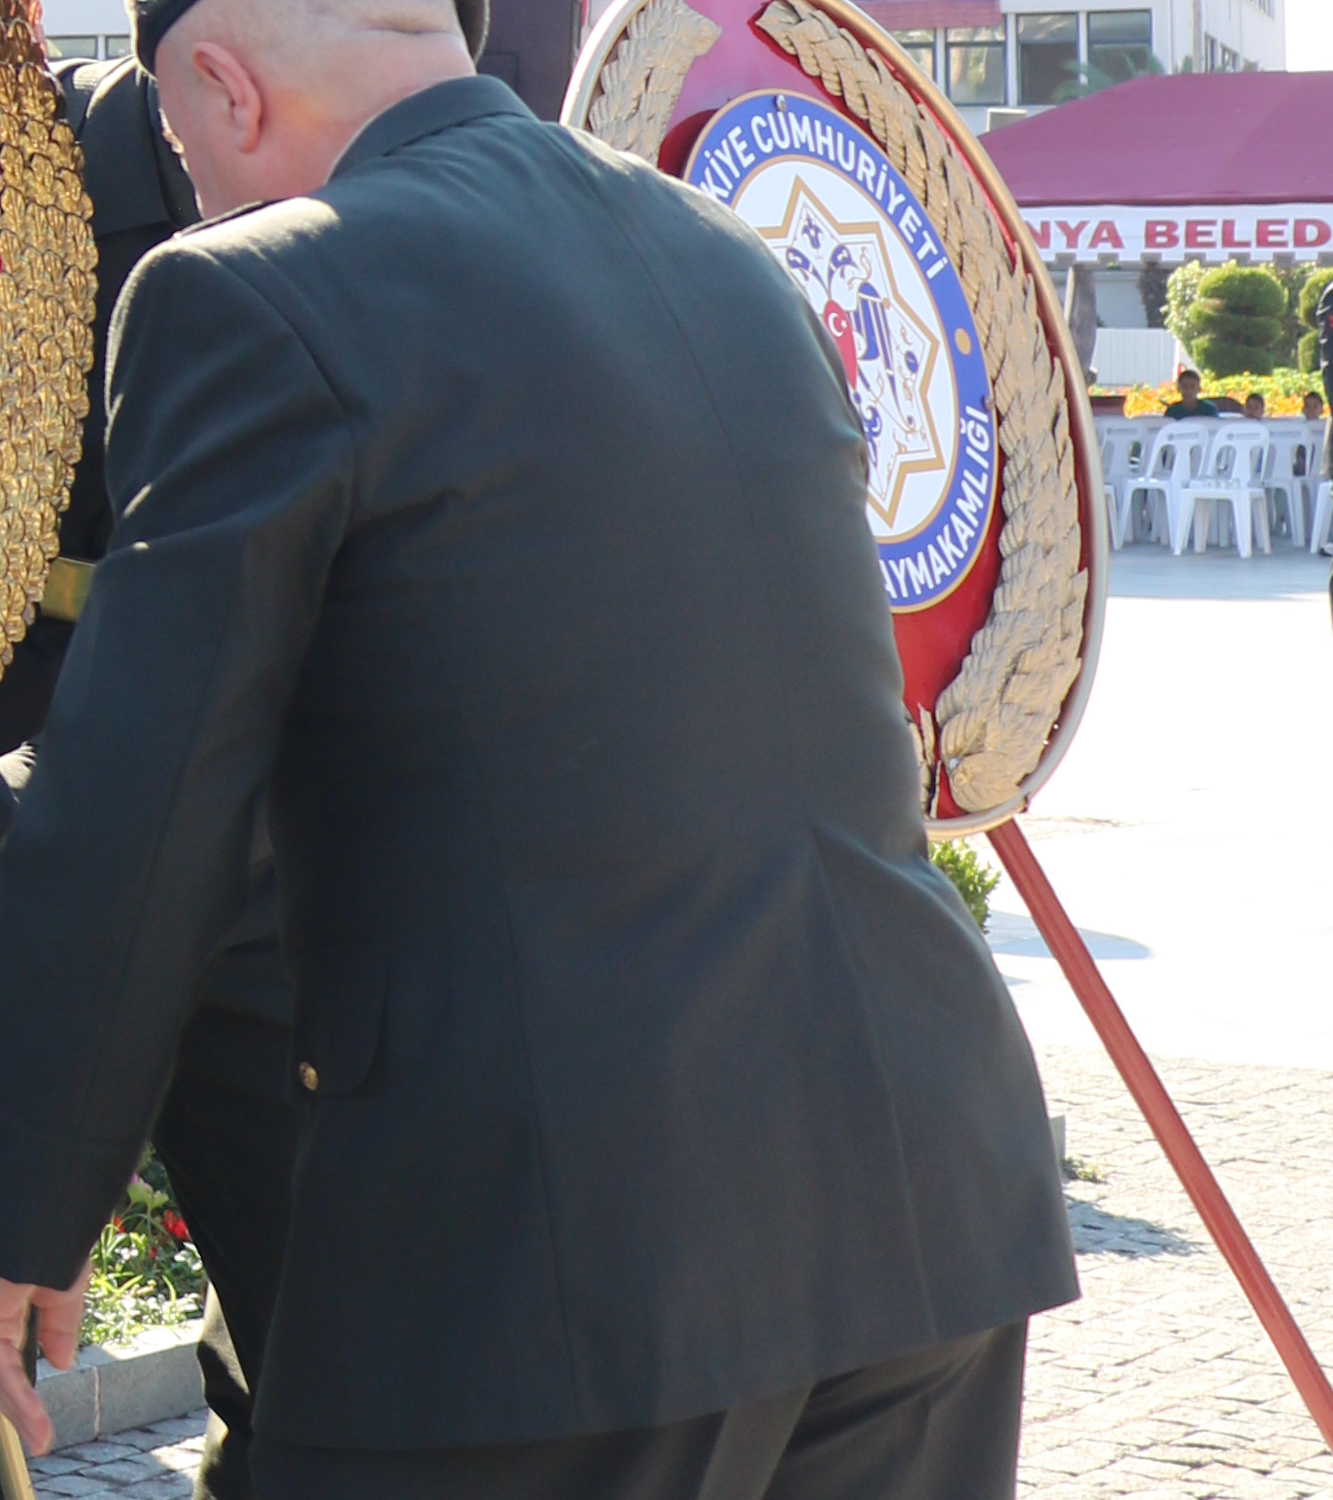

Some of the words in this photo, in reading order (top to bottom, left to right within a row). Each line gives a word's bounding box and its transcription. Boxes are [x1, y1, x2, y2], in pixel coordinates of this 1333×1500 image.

[699, 125, 756, 199] KİYE
[1023, 219, 1125, 249] NYA
[1144, 218, 1332, 249] BELED
[878, 405, 990, 599] AYMAKAMLIĞI
